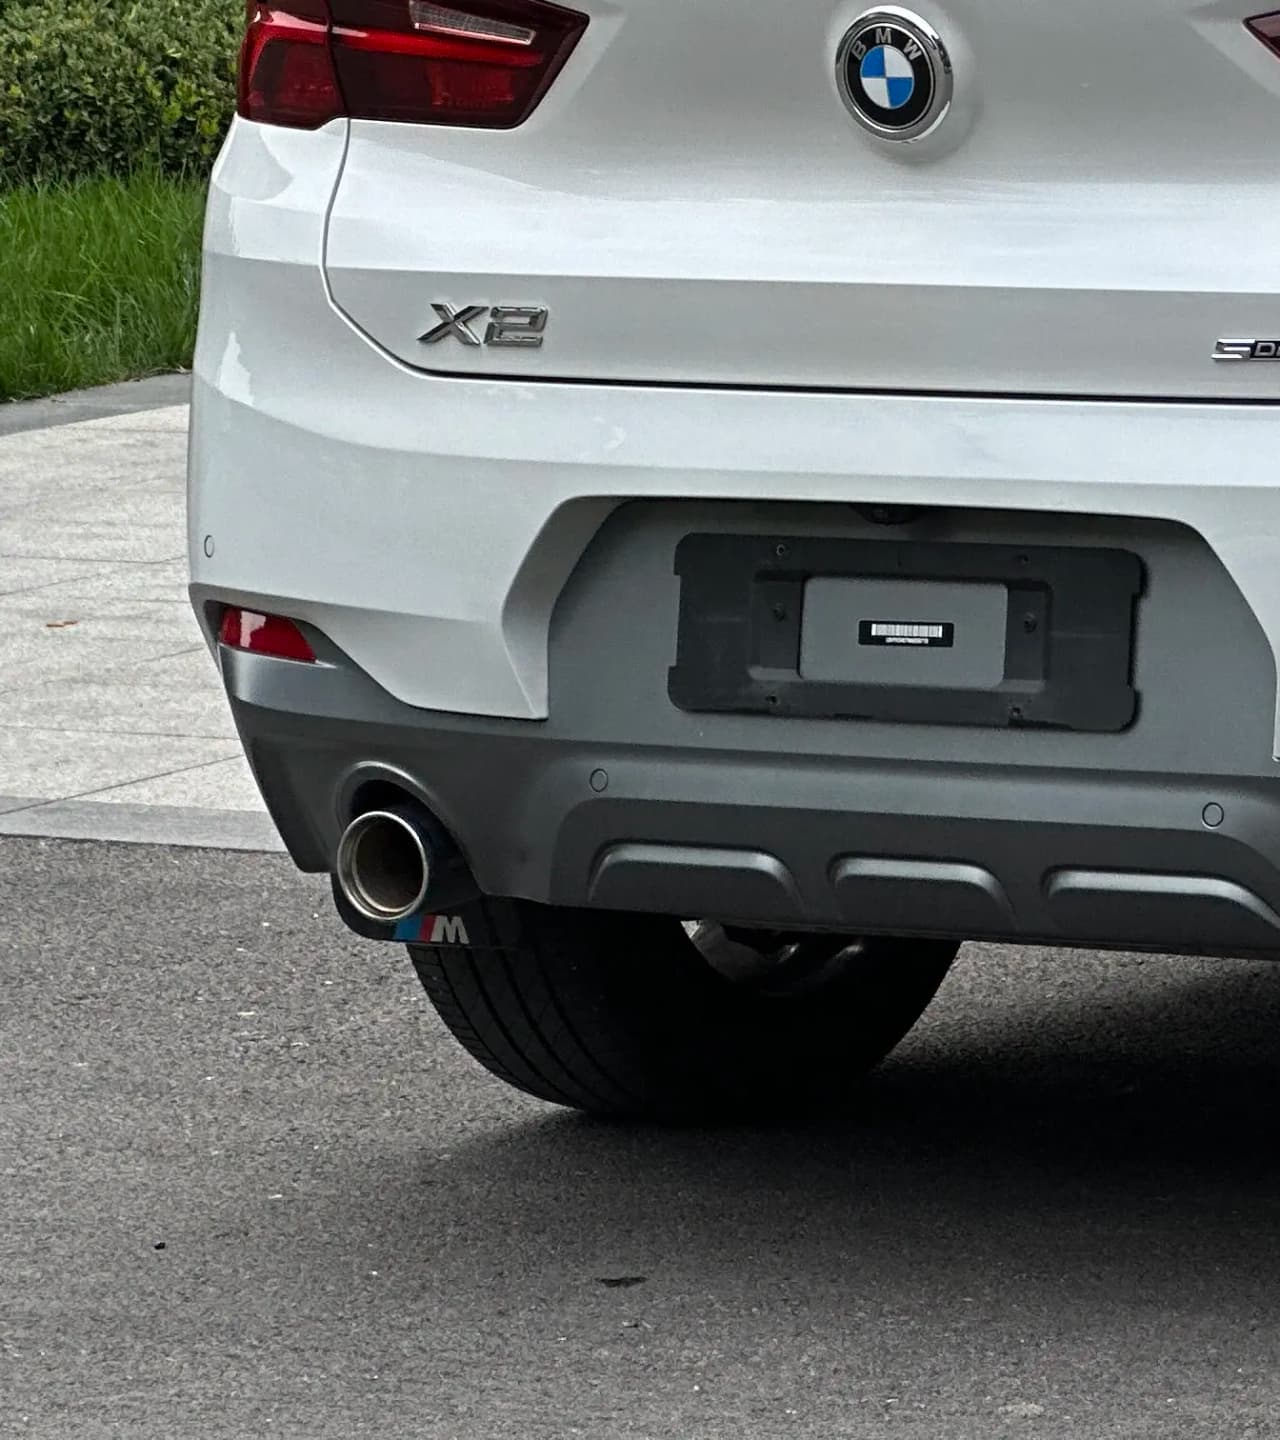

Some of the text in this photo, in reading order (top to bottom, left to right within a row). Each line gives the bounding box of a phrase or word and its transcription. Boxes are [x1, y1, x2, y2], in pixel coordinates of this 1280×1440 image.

[851, 27, 924, 61] BMW
[415, 302, 549, 348] X2
[430, 914, 470, 945] M
